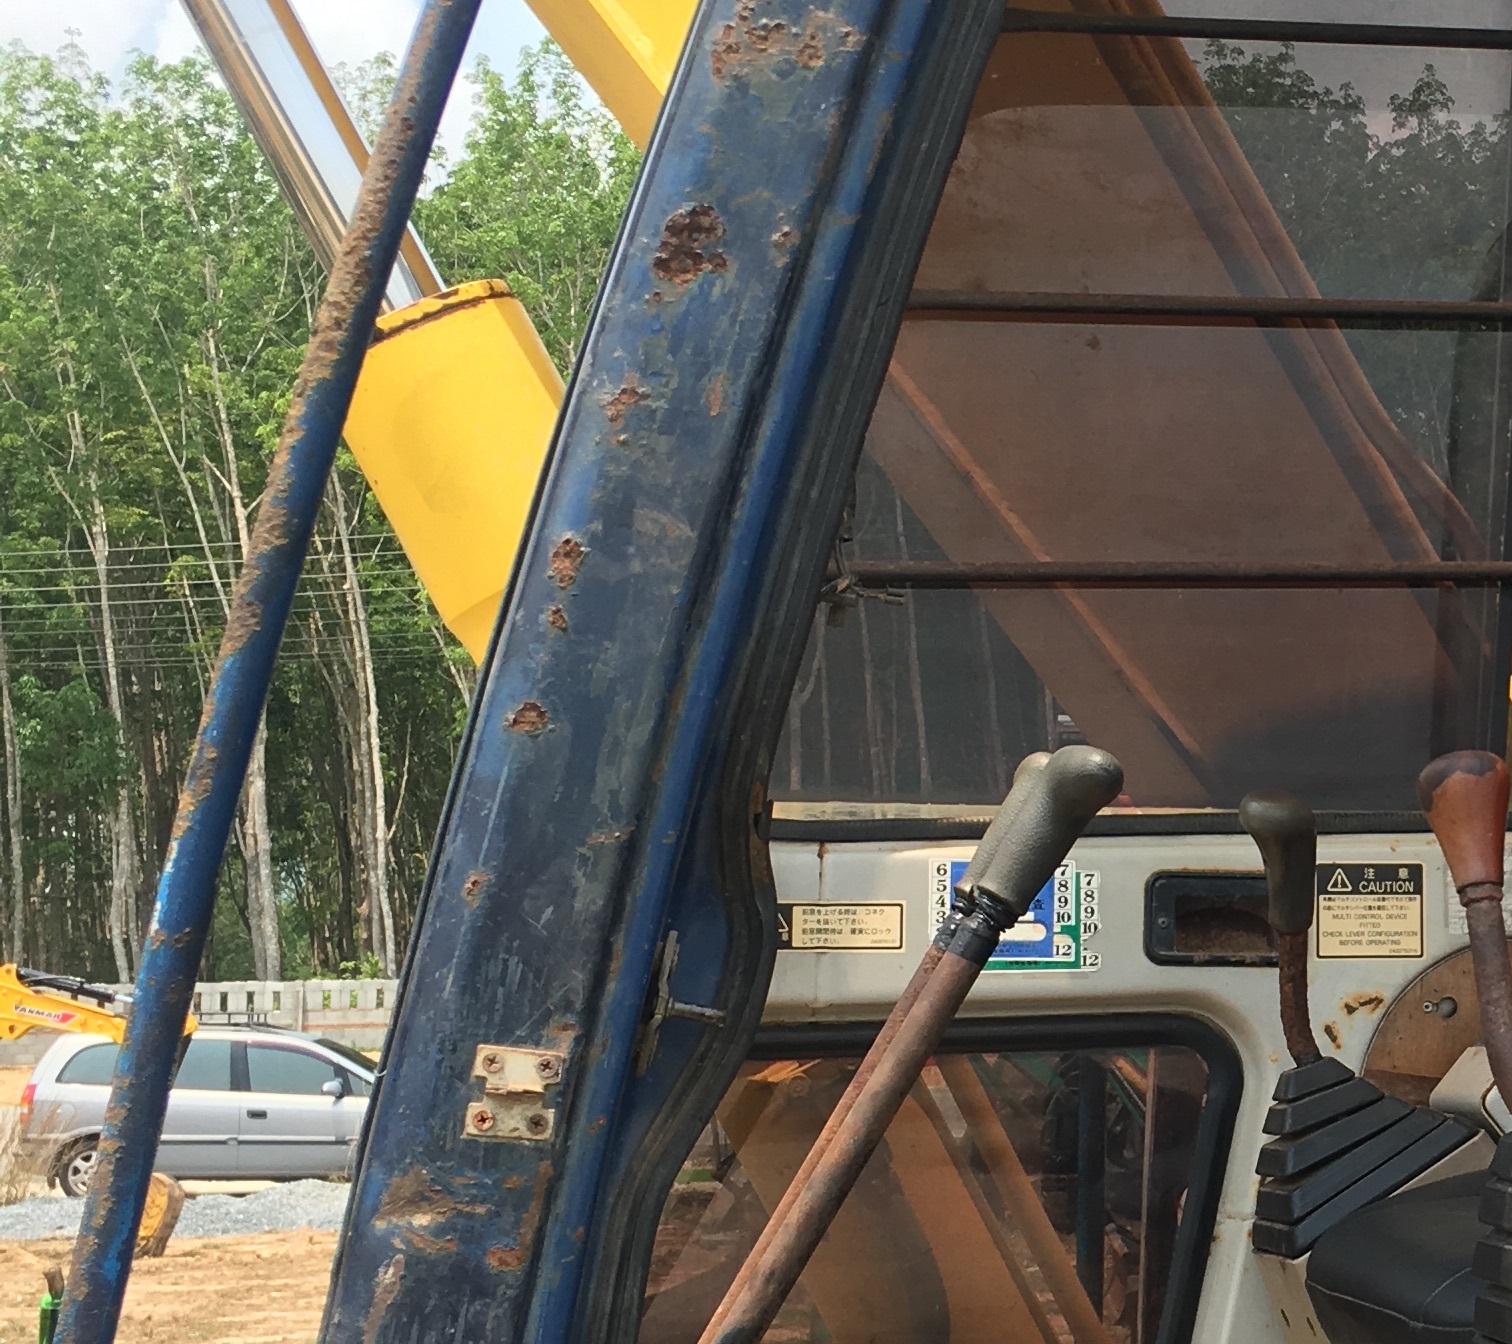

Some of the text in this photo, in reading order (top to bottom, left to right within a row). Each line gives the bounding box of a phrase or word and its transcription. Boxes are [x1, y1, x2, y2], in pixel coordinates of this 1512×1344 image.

[936, 864, 947, 876] 6
[1058, 864, 1069, 877] 7
[1084, 874, 1095, 885] 7
[936, 880, 947, 892] 5
[1057, 880, 1069, 892] 8
[1359, 881, 1414, 892] CAUTION
[935, 895, 947, 907] 4
[1057, 896, 1069, 908] 9
[1084, 891, 1095, 903] 8
[936, 911, 946, 923] 3
[1056, 912, 1071, 924] 10
[1084, 907, 1095, 919] 9
[1083, 922, 1098, 934] 10
[1055, 944, 1072, 956] 12
[1082, 955, 1099, 967] 12
